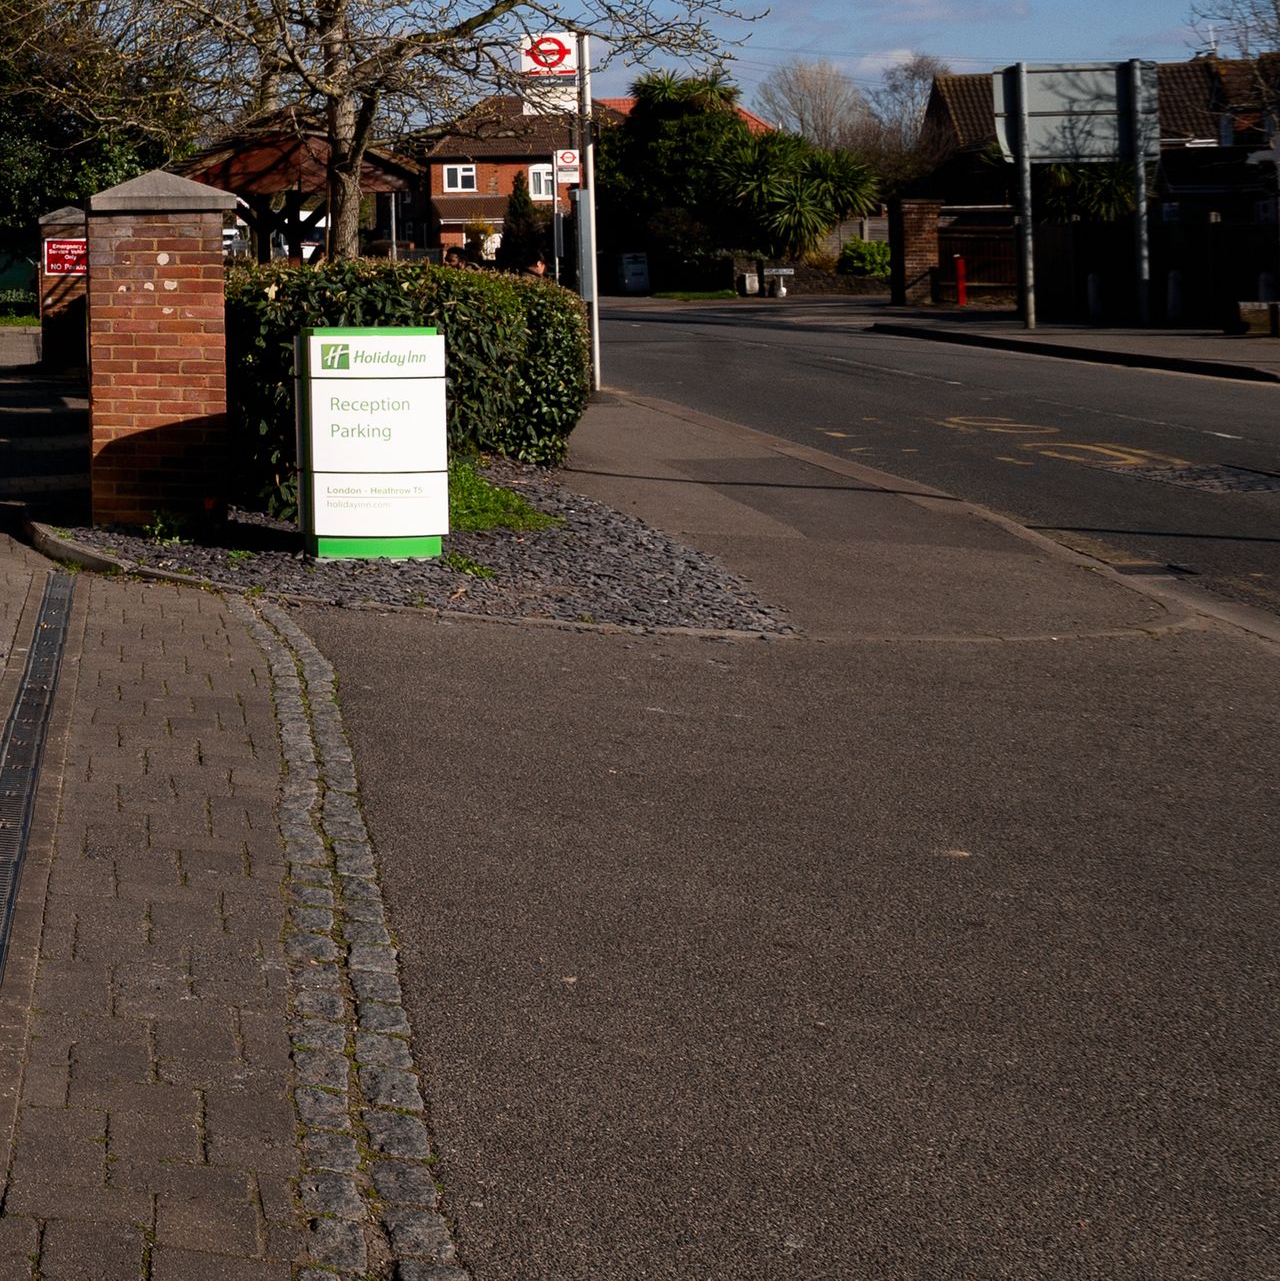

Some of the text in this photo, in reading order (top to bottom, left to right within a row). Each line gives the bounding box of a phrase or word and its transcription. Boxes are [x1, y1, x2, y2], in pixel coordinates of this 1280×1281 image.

[354, 350, 426, 366] Holiday Inn
[330, 397, 410, 414] Reception
[331, 423, 392, 442] Parking
[326, 500, 391, 509] holidayinn.com
